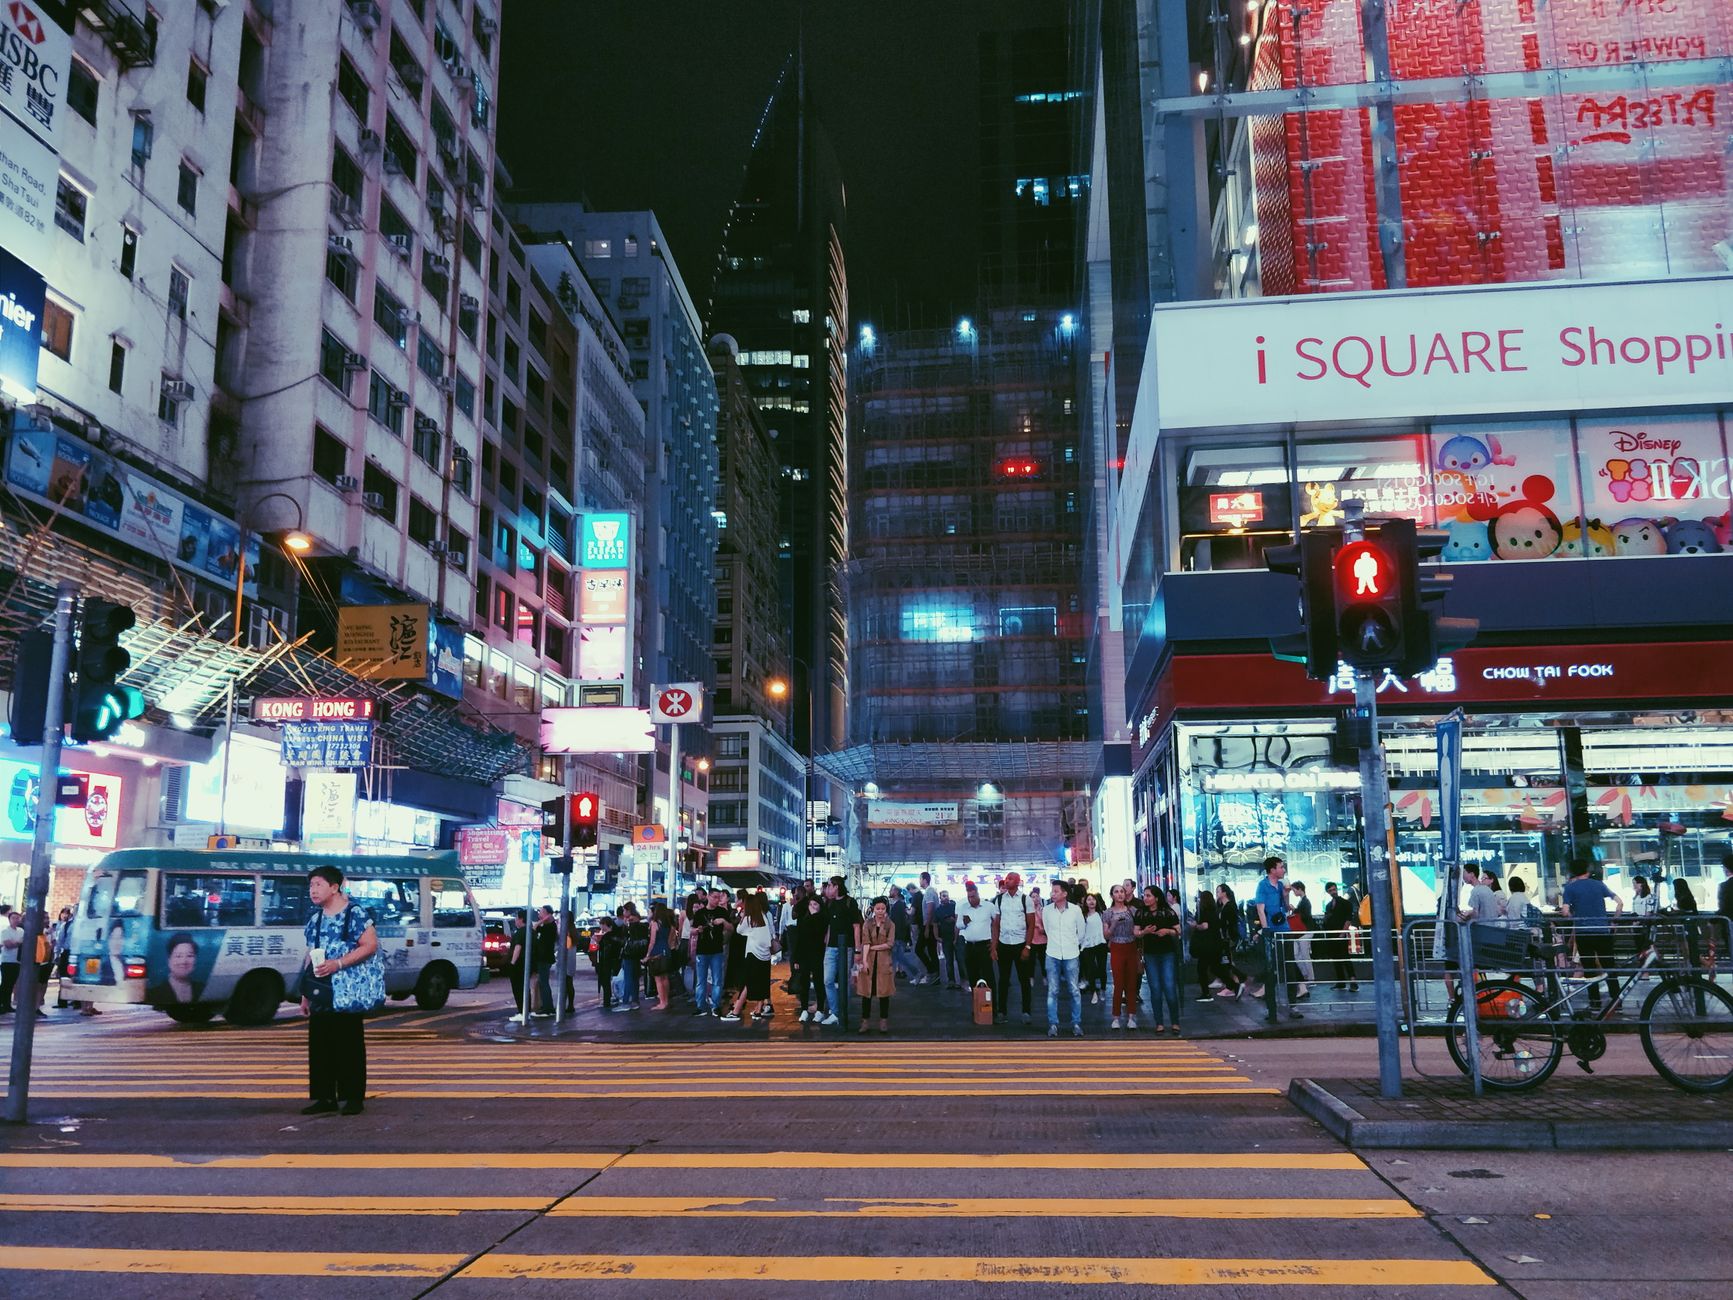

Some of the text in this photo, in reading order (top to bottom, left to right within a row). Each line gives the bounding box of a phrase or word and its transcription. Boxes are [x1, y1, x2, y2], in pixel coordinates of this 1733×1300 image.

[1255, 322, 1733, 388] i SQUARE Shoppi
[1482, 663, 1614, 680] CHOW TAI FOOK
[261, 702, 304, 718] KONG
[312, 701, 355, 717] HONG
[318, 734, 345, 742] CHINA
[348, 734, 369, 743] VISA
[636, 844, 662, 852] 24 hrs
